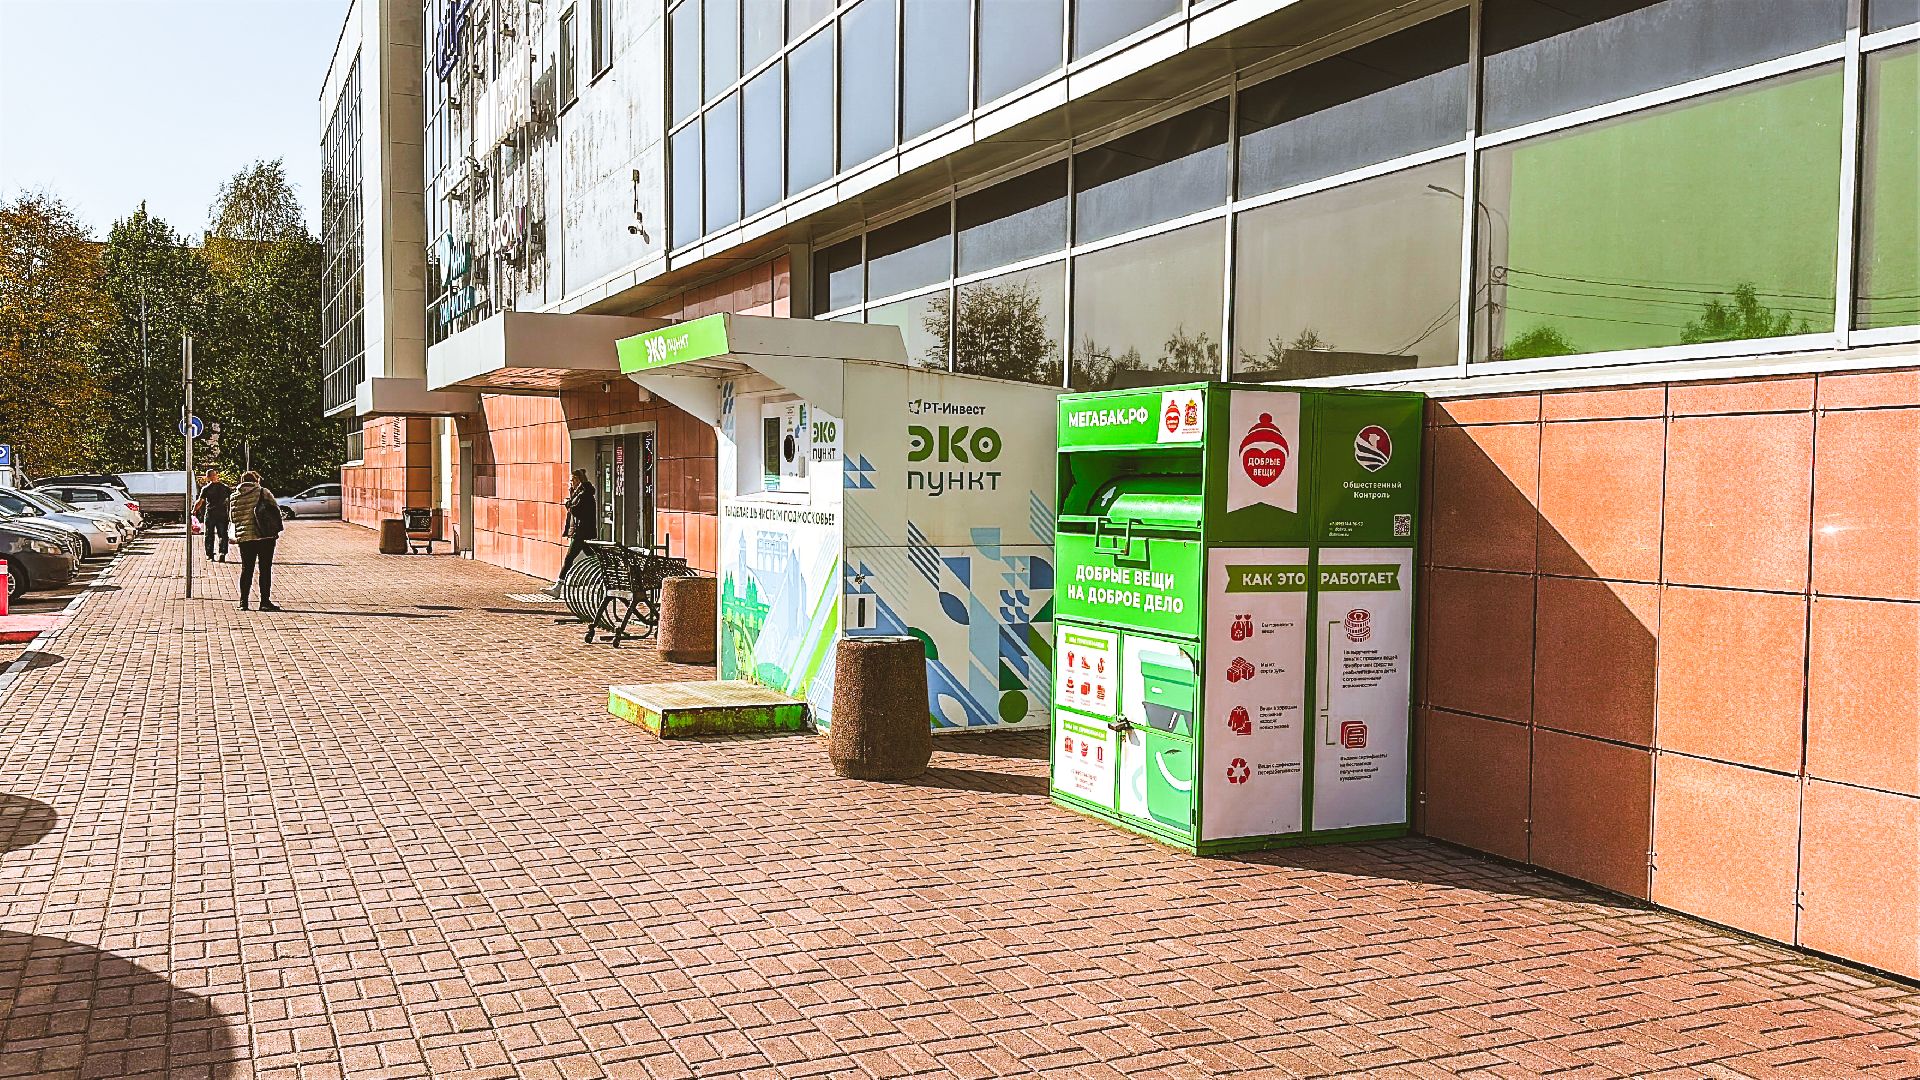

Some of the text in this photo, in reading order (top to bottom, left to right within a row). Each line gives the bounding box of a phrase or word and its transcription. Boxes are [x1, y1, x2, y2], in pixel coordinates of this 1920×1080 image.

[645, 335, 666, 363] ЭКО
[923, 402, 986, 415] РТ-Инвест
[1068, 406, 1149, 427] МЕГАБАК.РФ
[813, 422, 836, 443] ЭКО
[908, 425, 1002, 463] ЭКО
[1248, 457, 1280, 466] ДОБРЫЕ
[1253, 468, 1276, 477] ВЕЩИ
[1353, 491, 1391, 499] Контроль
[1076, 565, 1175, 592] ДОБРЫЕ ВЕЩИ
[1242, 572, 1394, 586] КАК ЭТО РАБОТАЕТ
[1067, 584, 1184, 614] НА ДОБРОЕ ДЕЛО
